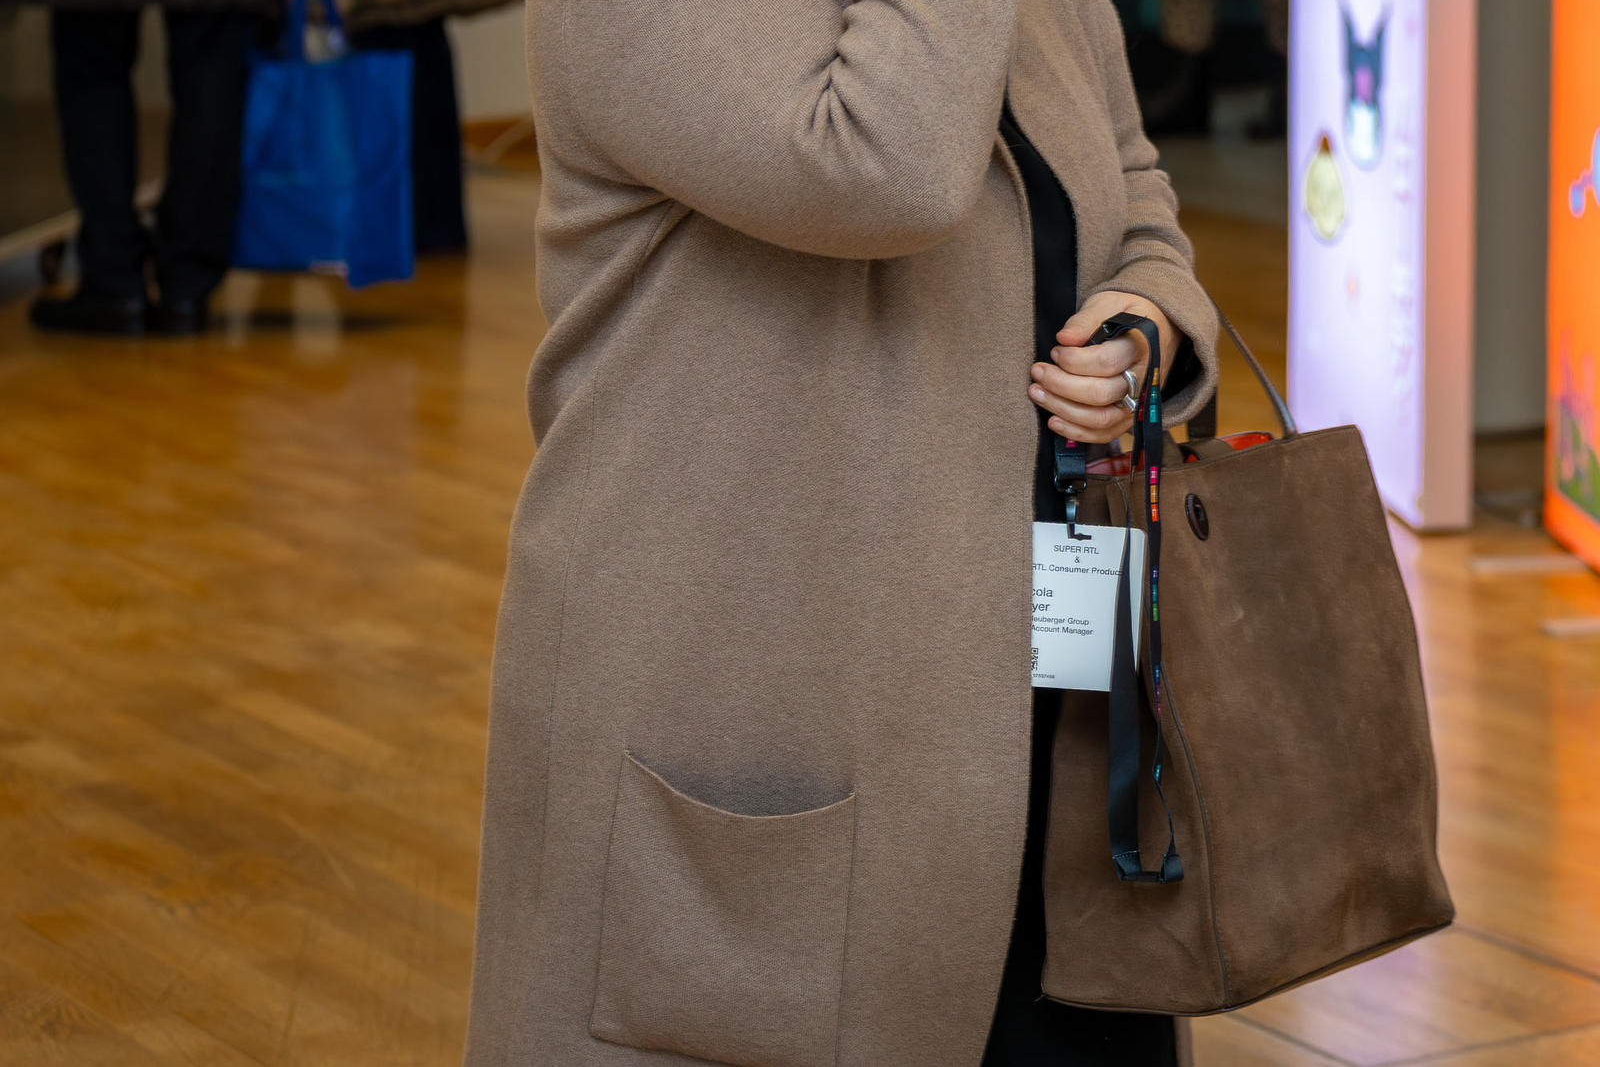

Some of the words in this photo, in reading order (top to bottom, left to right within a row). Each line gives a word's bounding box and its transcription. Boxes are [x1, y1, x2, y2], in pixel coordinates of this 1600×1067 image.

[1053, 544, 1082, 554] SUPER
[1083, 547, 1099, 555] RTL
[1074, 556, 1080, 564] &
[1032, 563, 1046, 571] RTL
[1048, 564, 1090, 574] Consumer
[1091, 567, 1123, 576] Produc
[1032, 587, 1053, 598] cola
[1032, 603, 1050, 613] yer
[1061, 626, 1094, 637] Manager
